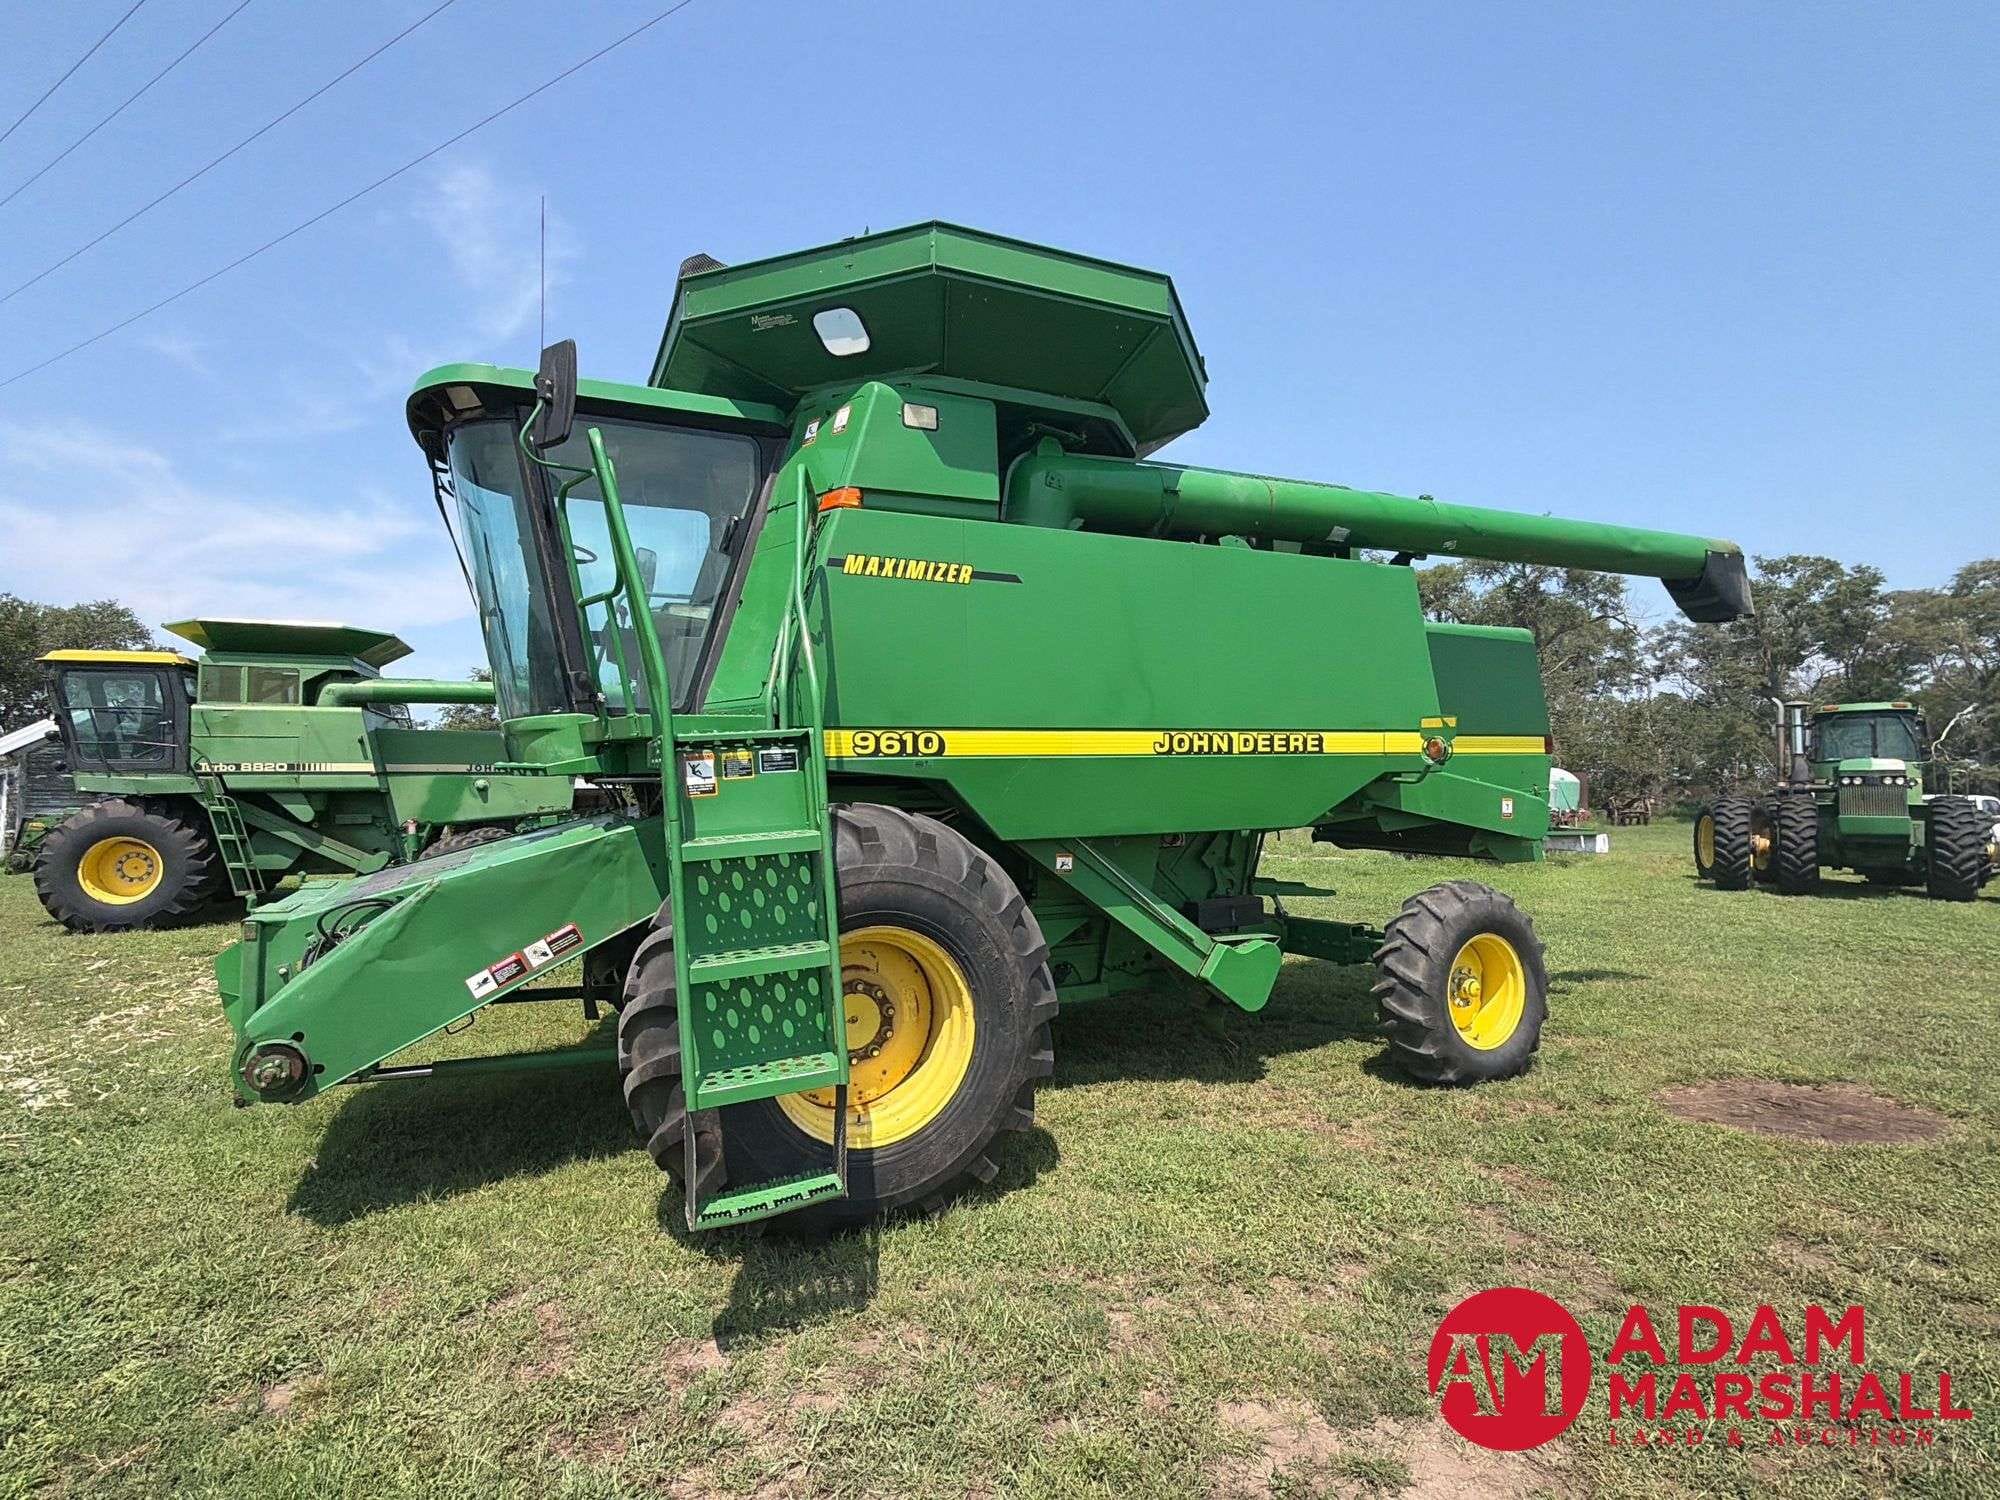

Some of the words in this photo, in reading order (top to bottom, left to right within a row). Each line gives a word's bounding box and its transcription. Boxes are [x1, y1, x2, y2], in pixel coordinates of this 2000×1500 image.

[842, 553, 975, 584] MAXIMIZER
[852, 731, 945, 756] 9610
[1153, 733, 1231, 754] JOHN
[1238, 733, 1324, 754] DEERE
[240, 762, 288, 772] 8820
